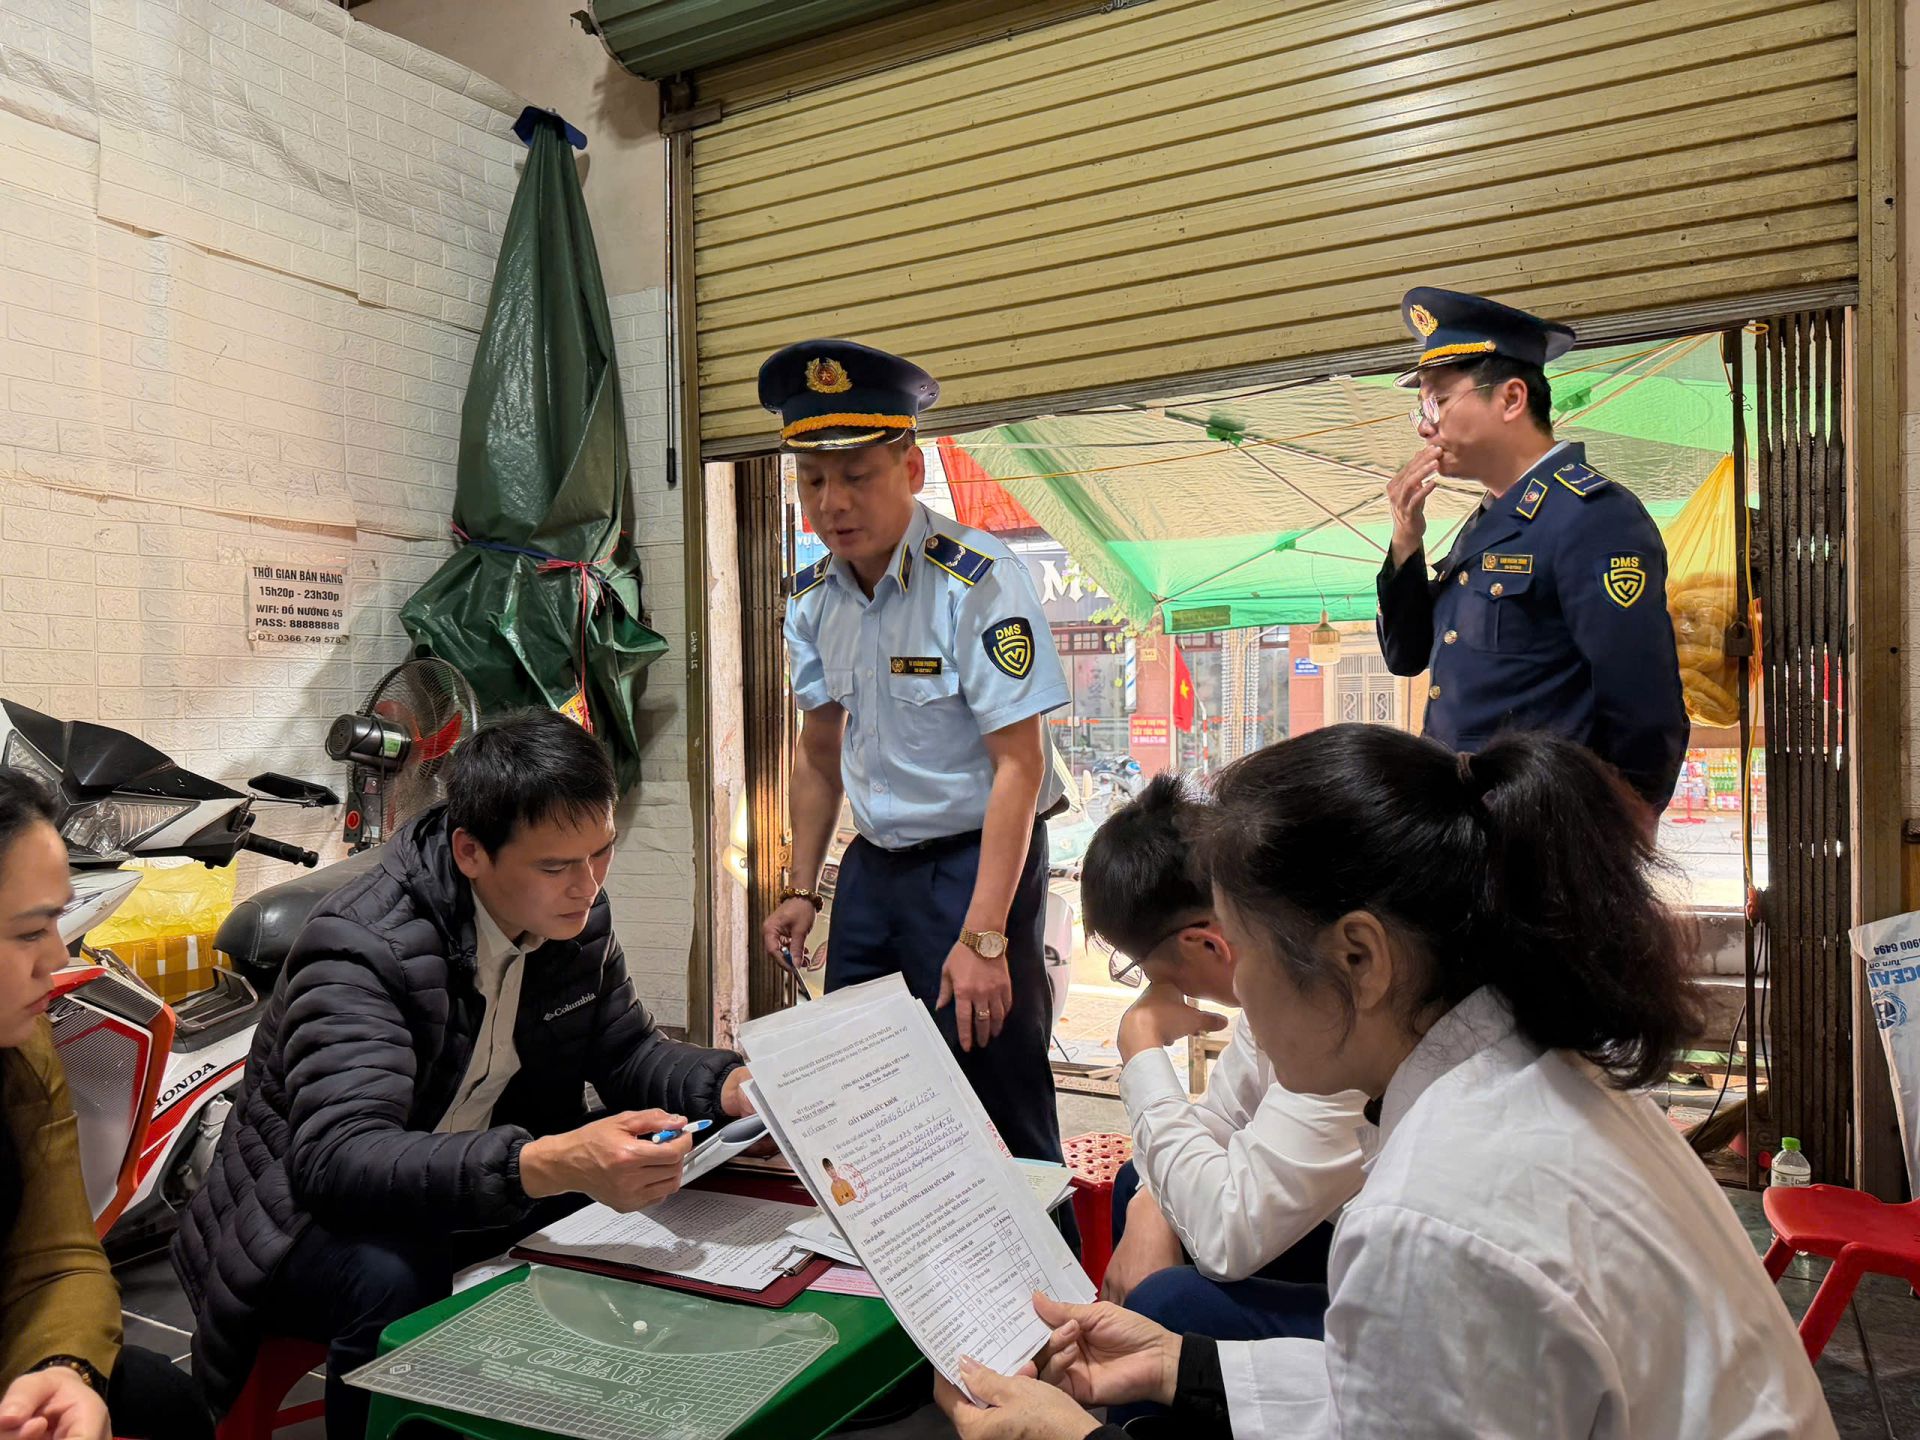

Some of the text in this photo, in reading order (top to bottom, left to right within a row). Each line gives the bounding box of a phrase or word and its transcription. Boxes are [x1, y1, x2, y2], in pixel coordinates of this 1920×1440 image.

[1610, 556, 1640, 568] DMS
[253, 565, 343, 584] THỜI GIAN BÁN HÀNG
[259, 586, 294, 598] 15h20p
[304, 589, 340, 602] 23h30p
[256, 604, 279, 614] WIFI:
[332, 609, 343, 618] 45
[256, 618, 287, 628] PASS:
[277, 634, 302, 642] 0366
[304, 635, 322, 643] 749
[324, 636, 341, 644] 578
[995, 623, 1021, 640] DMS
[1873, 943, 1898, 955] 6494
[1882, 959, 1901, 968] Turn
[554, 992, 597, 1017] Columbia
[470, 1335, 528, 1359] My
[527, 1348, 652, 1386] CLEAR
[601, 1389, 695, 1421] BAG
